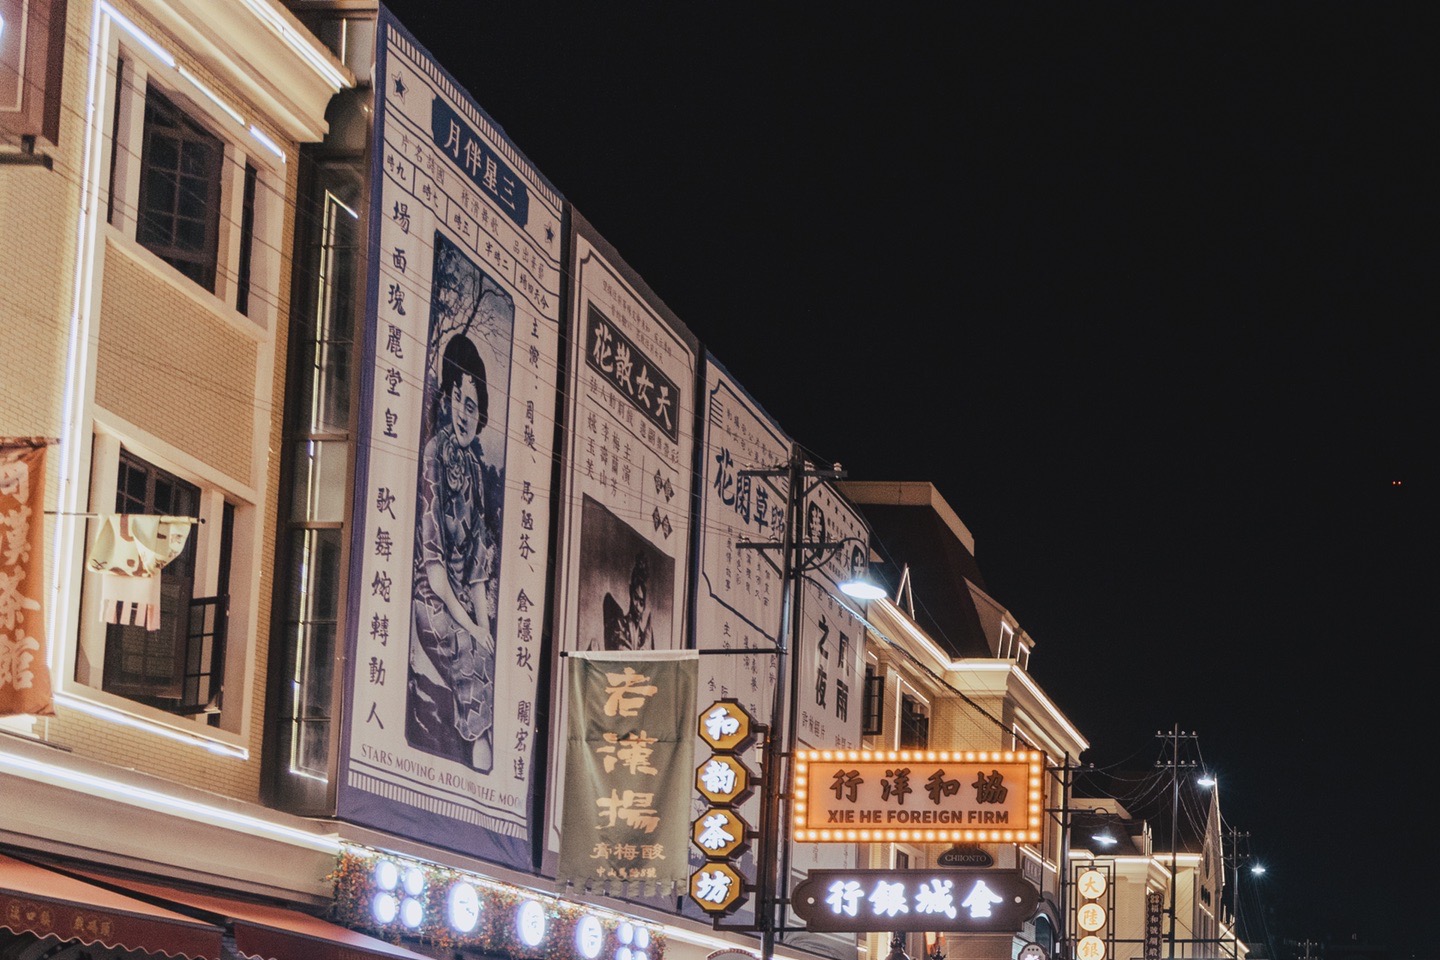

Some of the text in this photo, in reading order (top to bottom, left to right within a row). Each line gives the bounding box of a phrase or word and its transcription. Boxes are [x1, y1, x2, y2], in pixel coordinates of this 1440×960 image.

[361, 743, 393, 766] STARS
[395, 757, 436, 781] MOVING
[829, 767, 1008, 805] 協和洋行
[827, 809, 1009, 824] XIE HE FOREIGN FIRM
[826, 878, 1004, 920] 金城銀行
